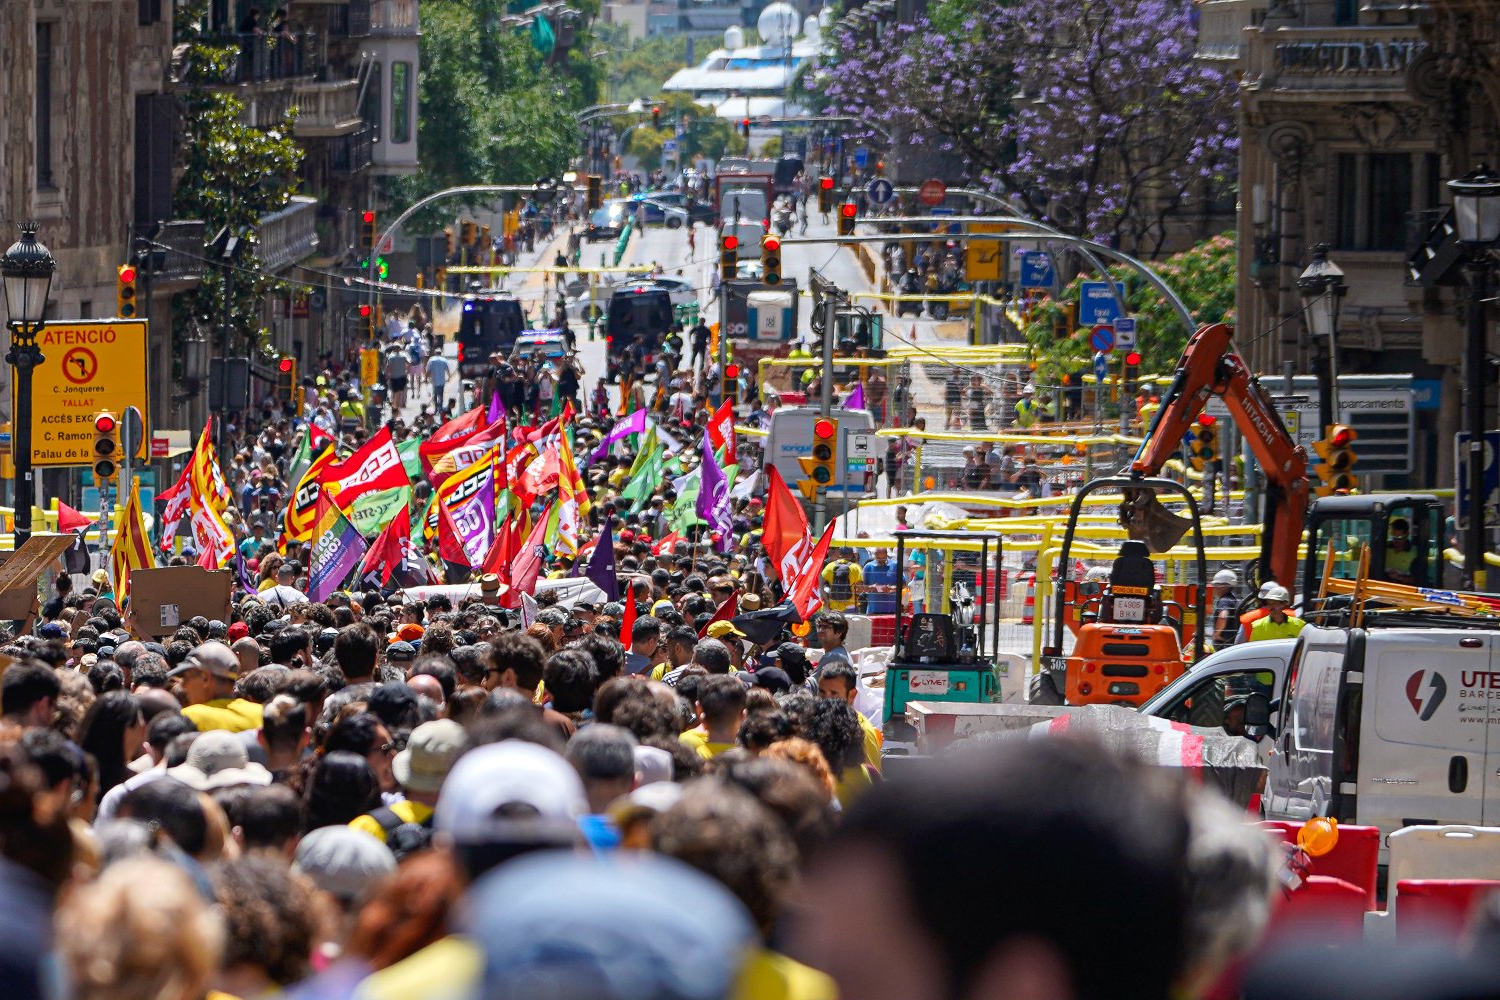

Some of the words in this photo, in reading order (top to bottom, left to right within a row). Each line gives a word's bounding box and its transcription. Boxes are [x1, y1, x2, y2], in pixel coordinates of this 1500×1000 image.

[43, 328, 116, 345] ATENCIÓ
[63, 386, 105, 394] Jonqueres
[63, 399, 94, 407] TALLAT
[41, 414, 73, 424] ACCÉS
[1241, 397, 1274, 445] HITACHI
[44, 432, 54, 441] C.
[58, 431, 92, 441] Ramon
[34, 449, 62, 459] Palau
[65, 449, 77, 458] de
[80, 449, 89, 458] la
